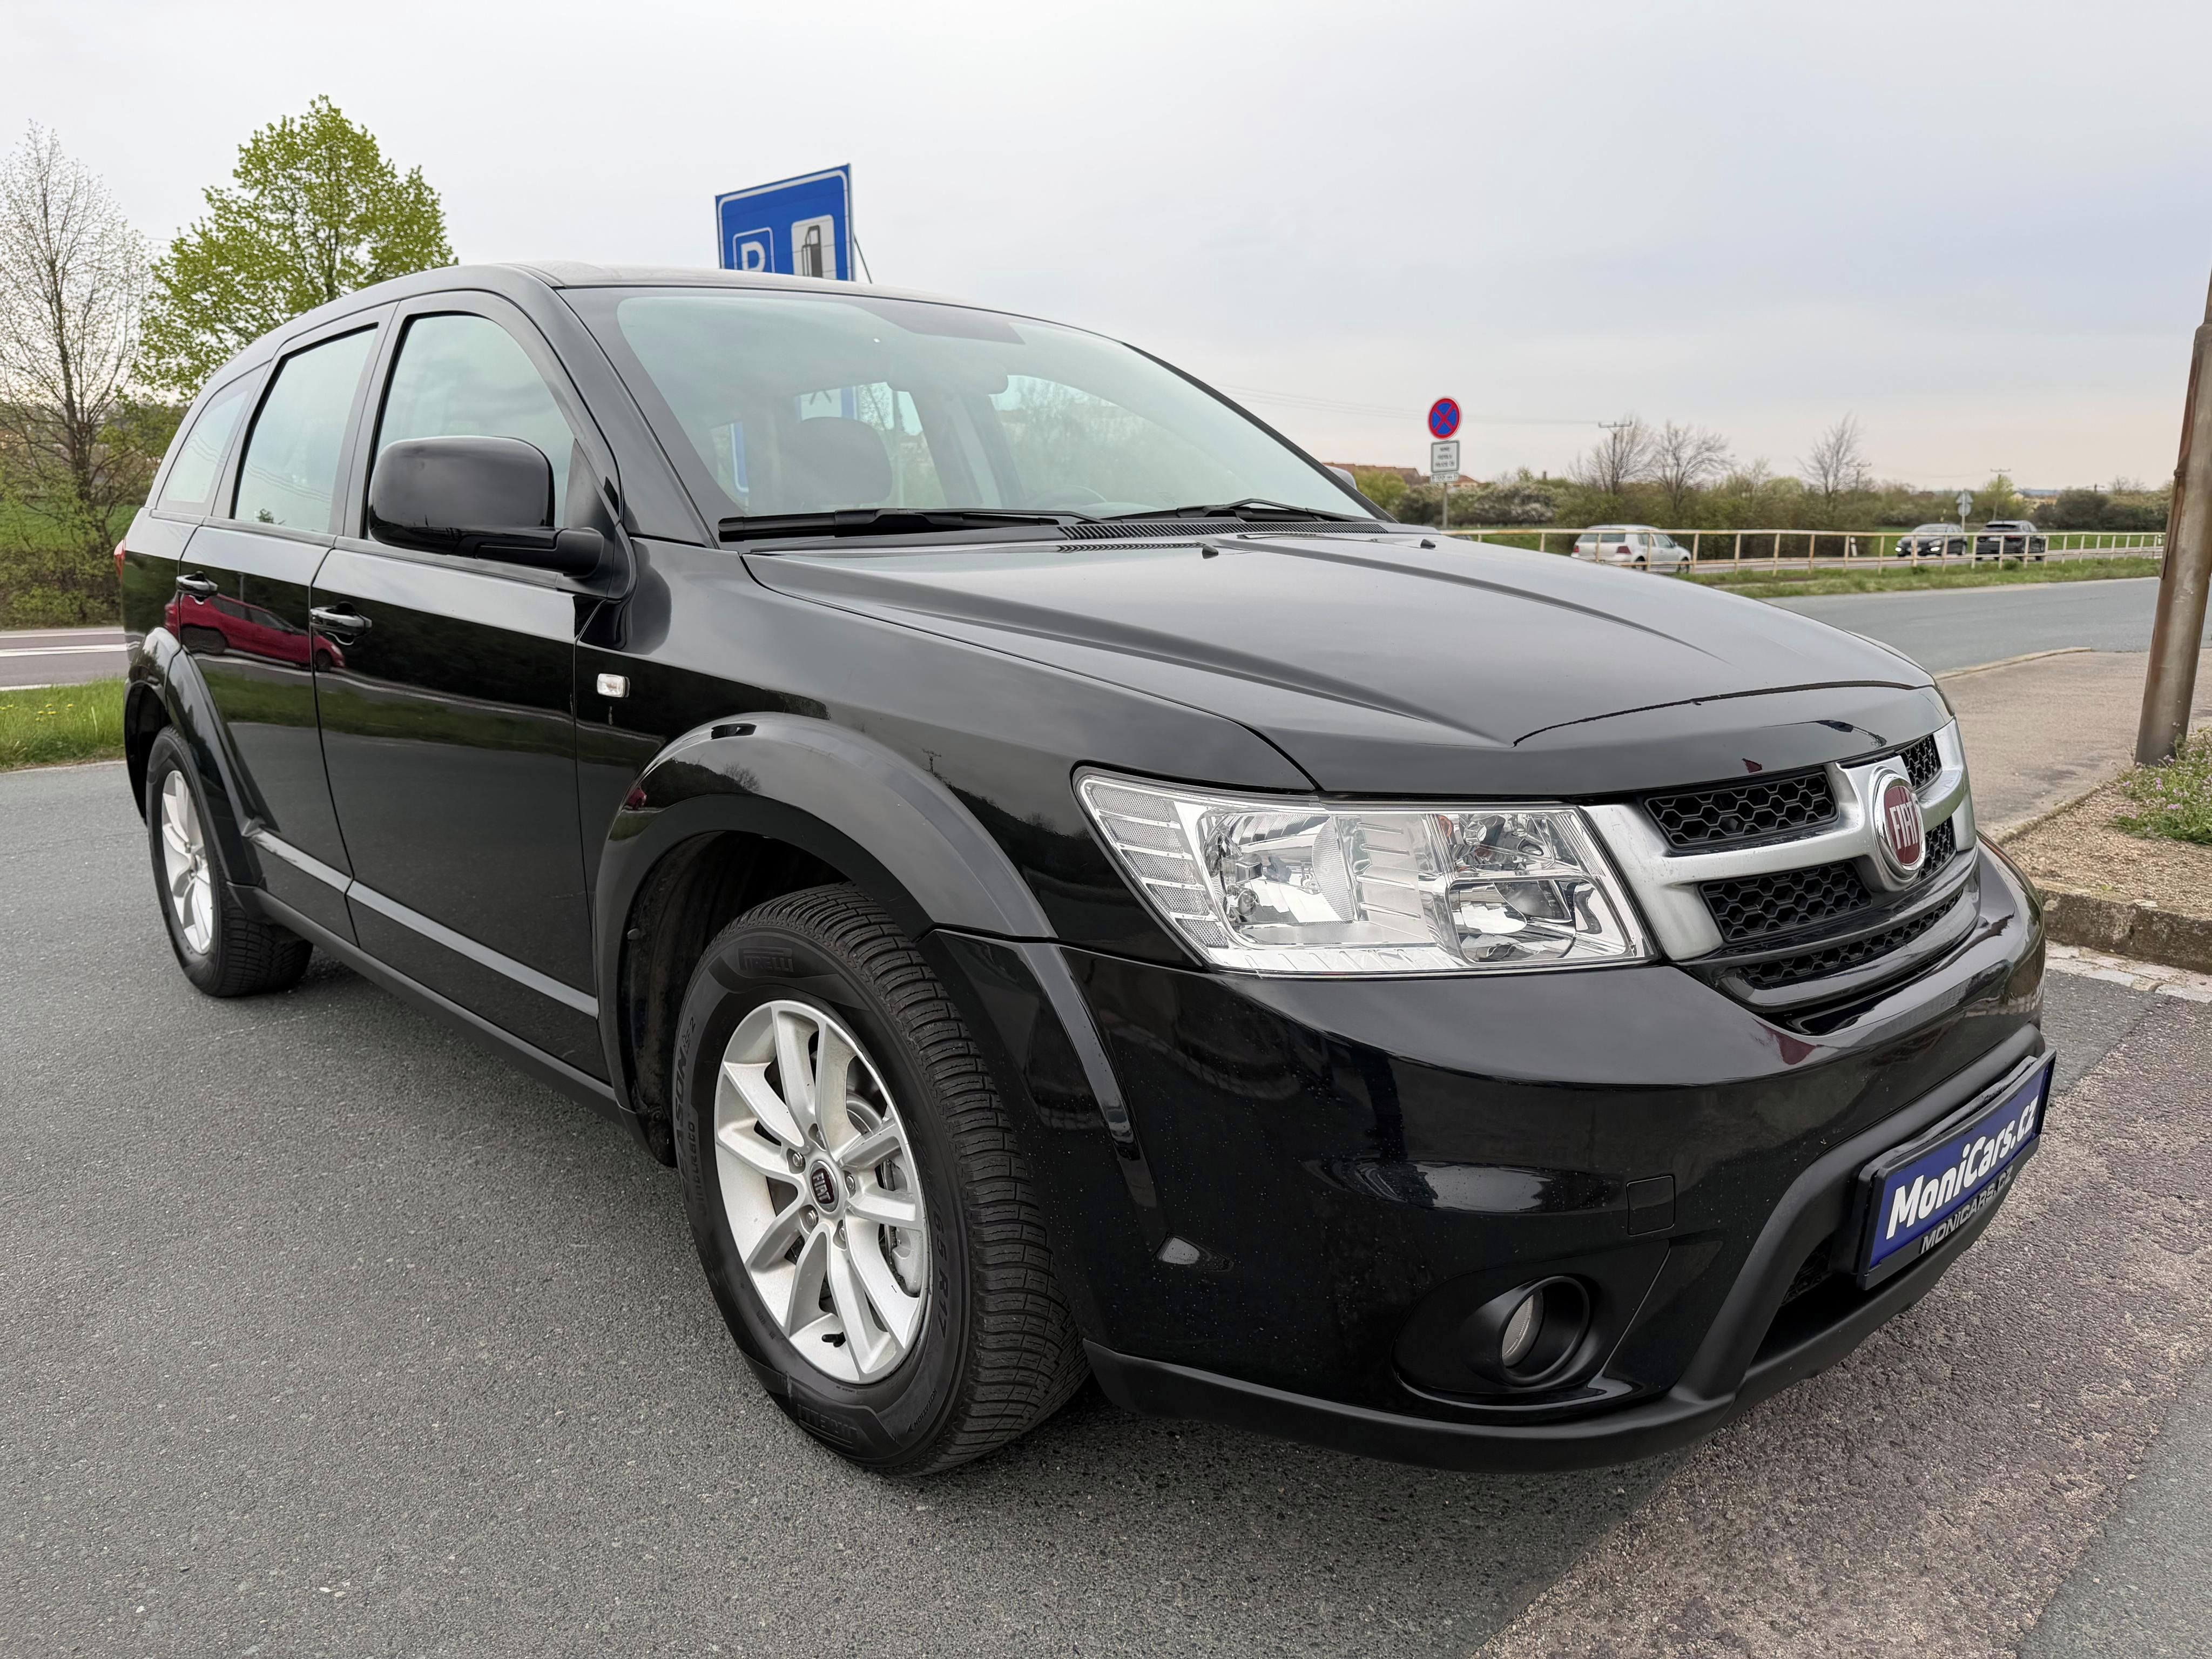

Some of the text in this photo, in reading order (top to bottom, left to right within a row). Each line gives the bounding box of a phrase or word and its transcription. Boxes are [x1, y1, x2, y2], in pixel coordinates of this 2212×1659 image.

[740, 240, 766, 273] P
[1889, 801, 1918, 850] FIAT
[738, 946, 794, 973] PIRELLI
[813, 1172, 831, 1201] FIAT
[1886, 1095, 2039, 1240] MoniCars.cz
[1919, 1165, 2013, 1254] MONICARS.CZ
[926, 1266, 948, 1339] R17
[914, 1387, 937, 1428] ROTATION
